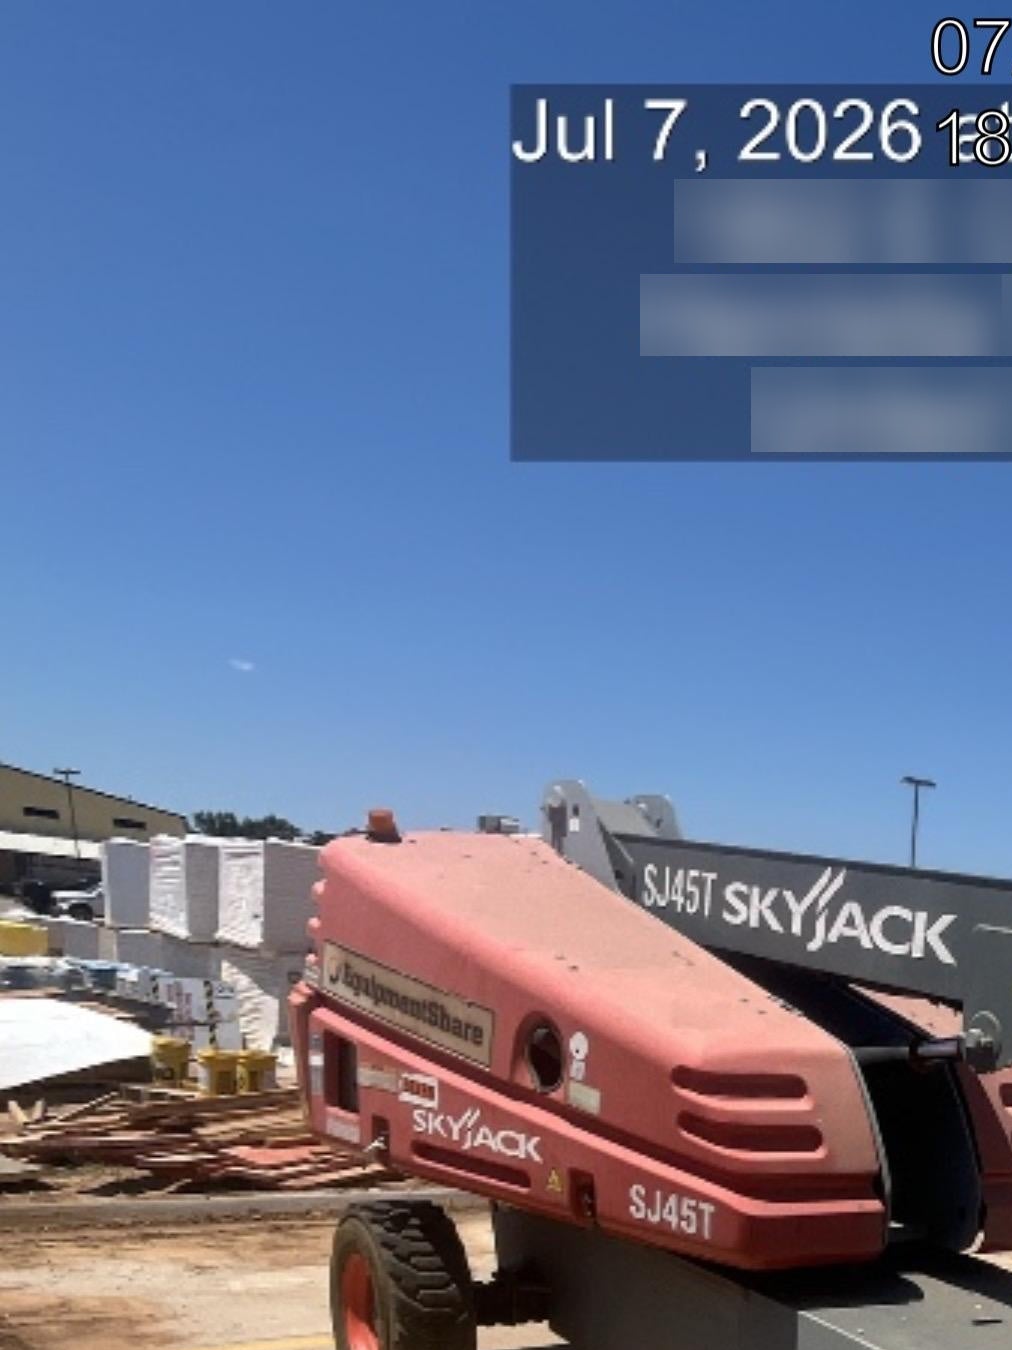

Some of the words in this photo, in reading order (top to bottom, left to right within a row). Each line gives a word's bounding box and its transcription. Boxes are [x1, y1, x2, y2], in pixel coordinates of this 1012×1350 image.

[642, 862, 718, 918] SJ45T
[722, 866, 958, 967] SKYJACK
[341, 960, 485, 1046] EquipmentShare
[412, 1107, 543, 1163] SKYJACK
[629, 1184, 715, 1240] SJ45T
